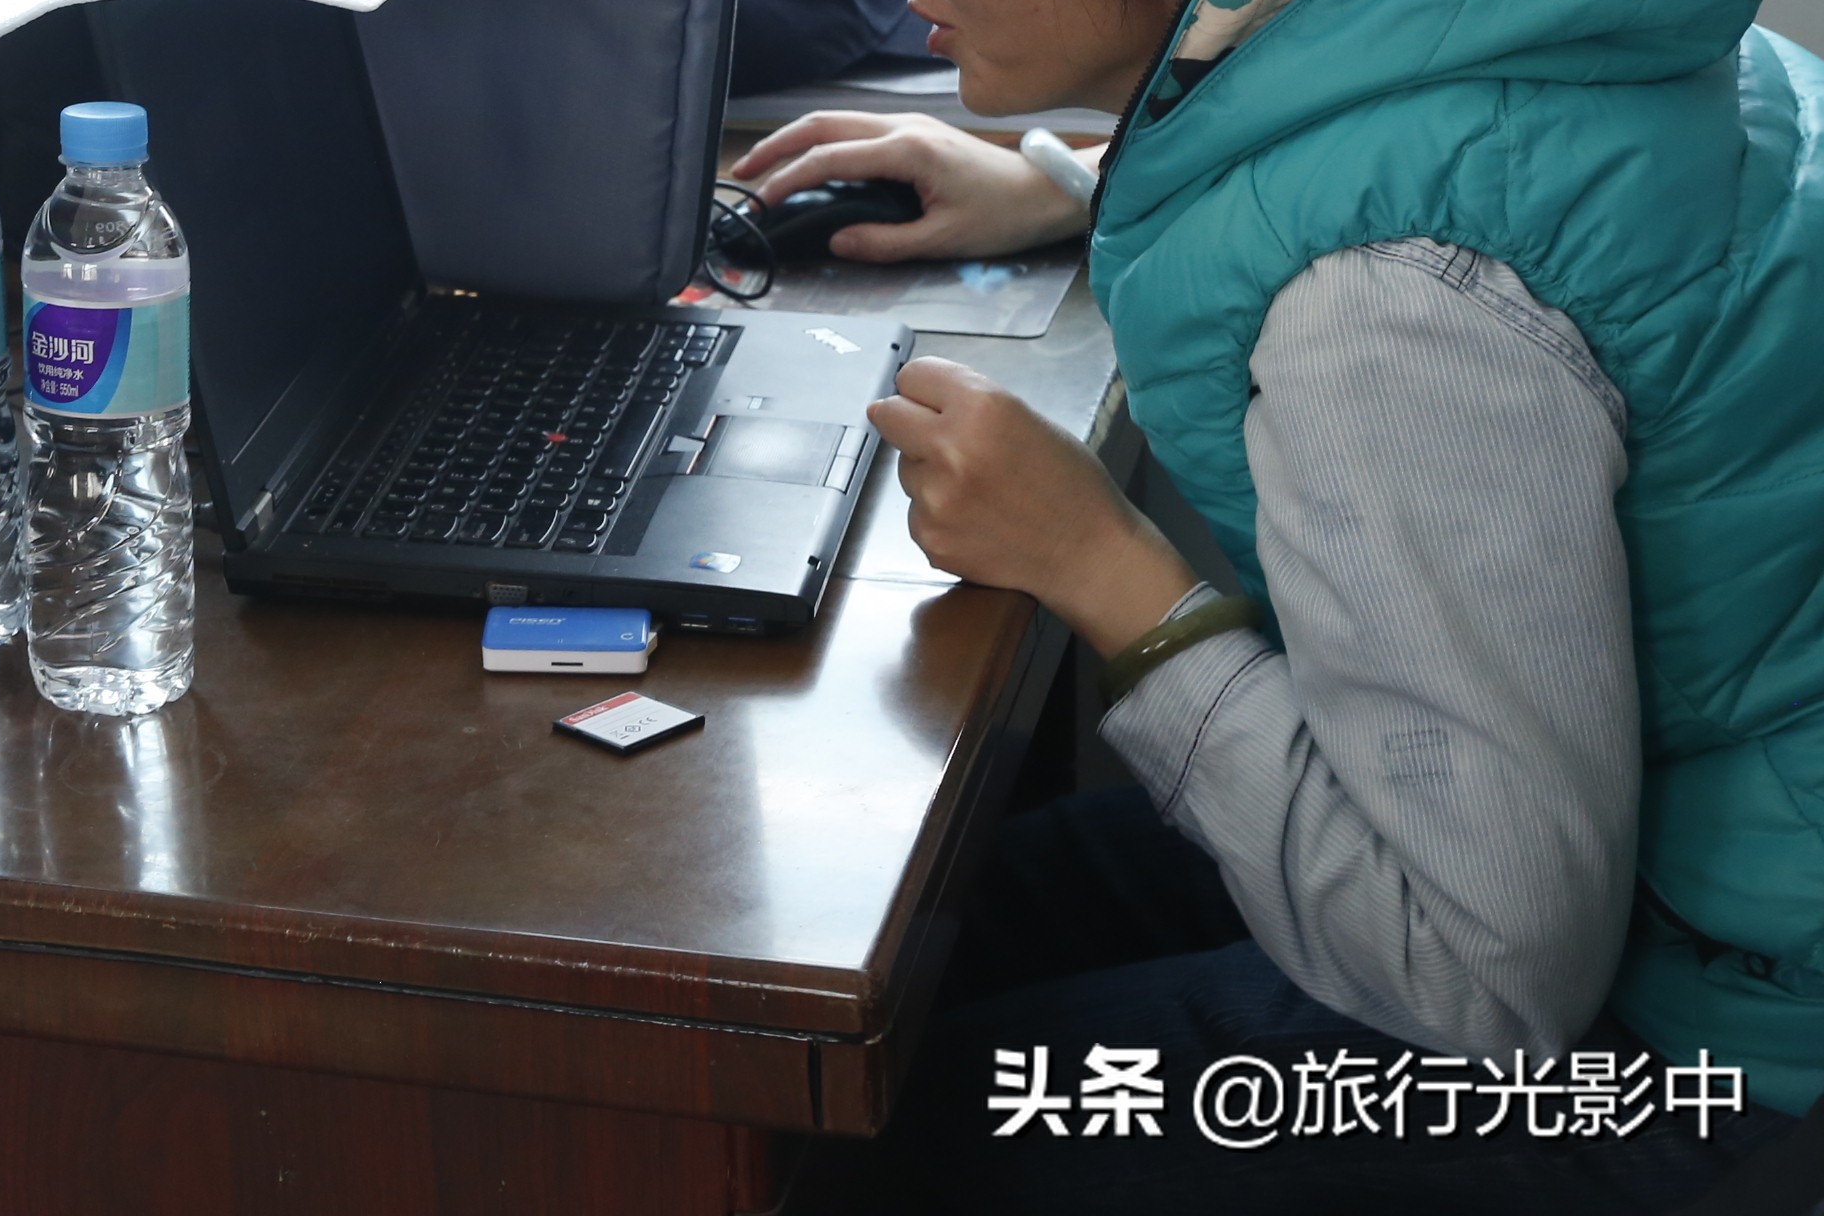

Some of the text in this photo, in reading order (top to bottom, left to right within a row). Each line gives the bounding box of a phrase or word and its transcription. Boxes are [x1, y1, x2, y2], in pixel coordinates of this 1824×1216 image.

[32, 332, 95, 364] 金沙河
[38, 362, 85, 381] 饮用纯净水
